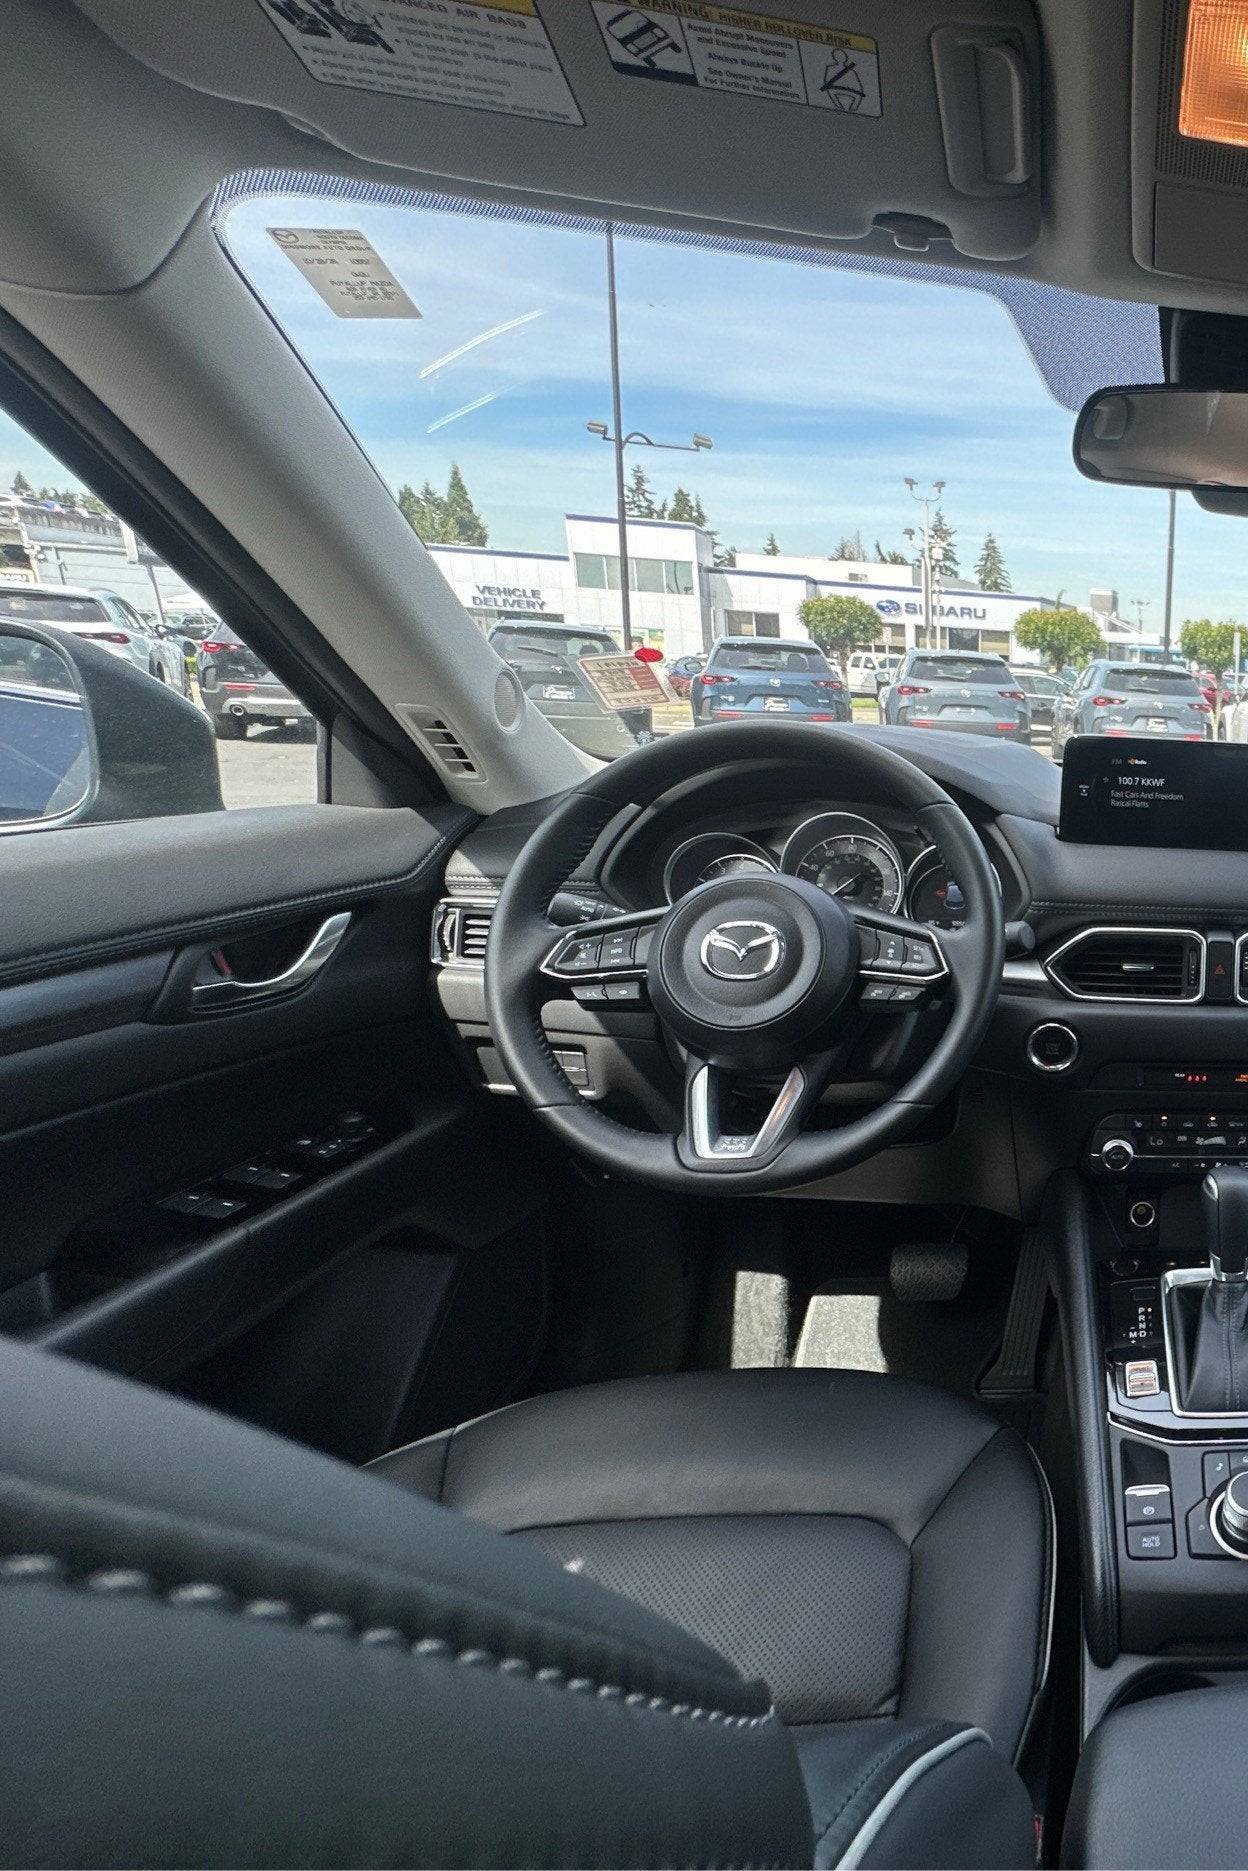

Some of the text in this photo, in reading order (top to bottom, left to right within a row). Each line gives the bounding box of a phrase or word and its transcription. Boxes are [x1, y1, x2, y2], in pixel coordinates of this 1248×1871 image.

[475, 585, 541, 599] VEHICLE
[472, 596, 546, 611] DELIVERY
[1118, 777, 1165, 787] 100.7 KKWF
[1111, 790, 1184, 800] Fast Cars And Freedom
[1111, 799, 1149, 808] Rascal Flatts
[1150, 1136, 1164, 1145] Lo
